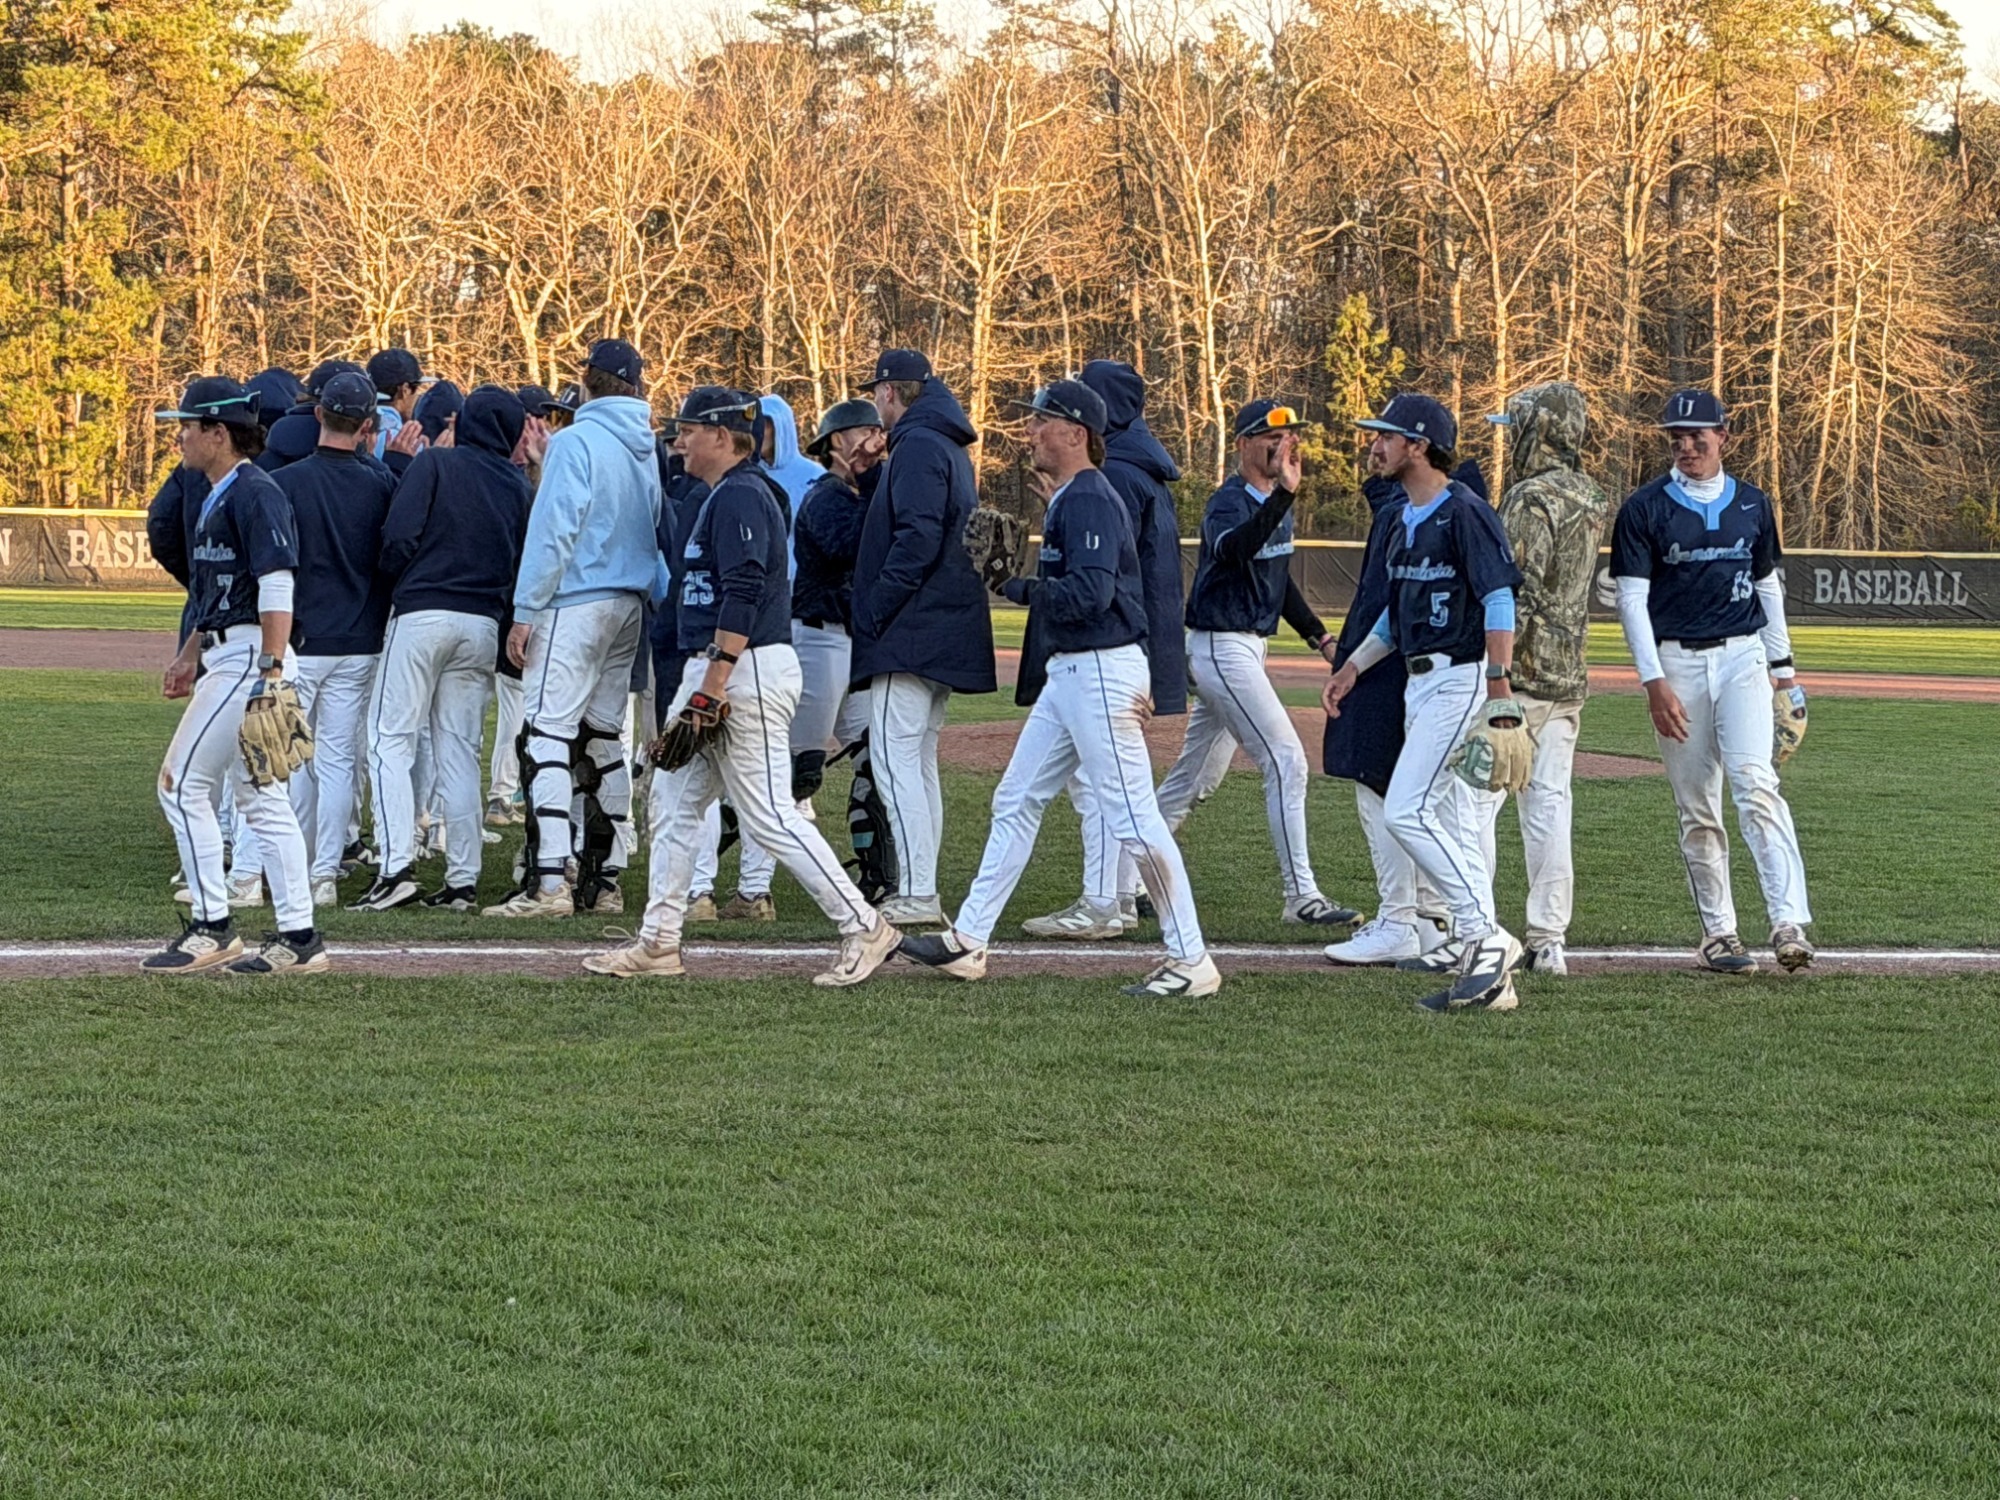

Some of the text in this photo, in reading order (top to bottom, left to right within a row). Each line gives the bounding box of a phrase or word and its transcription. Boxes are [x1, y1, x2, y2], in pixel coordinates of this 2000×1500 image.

[67, 529, 163, 569] BASE
[216, 574, 234, 610] 7
[683, 570, 715, 606] 25
[1813, 567, 1969, 607] BASEBALL
[1429, 592, 1451, 627] 5
